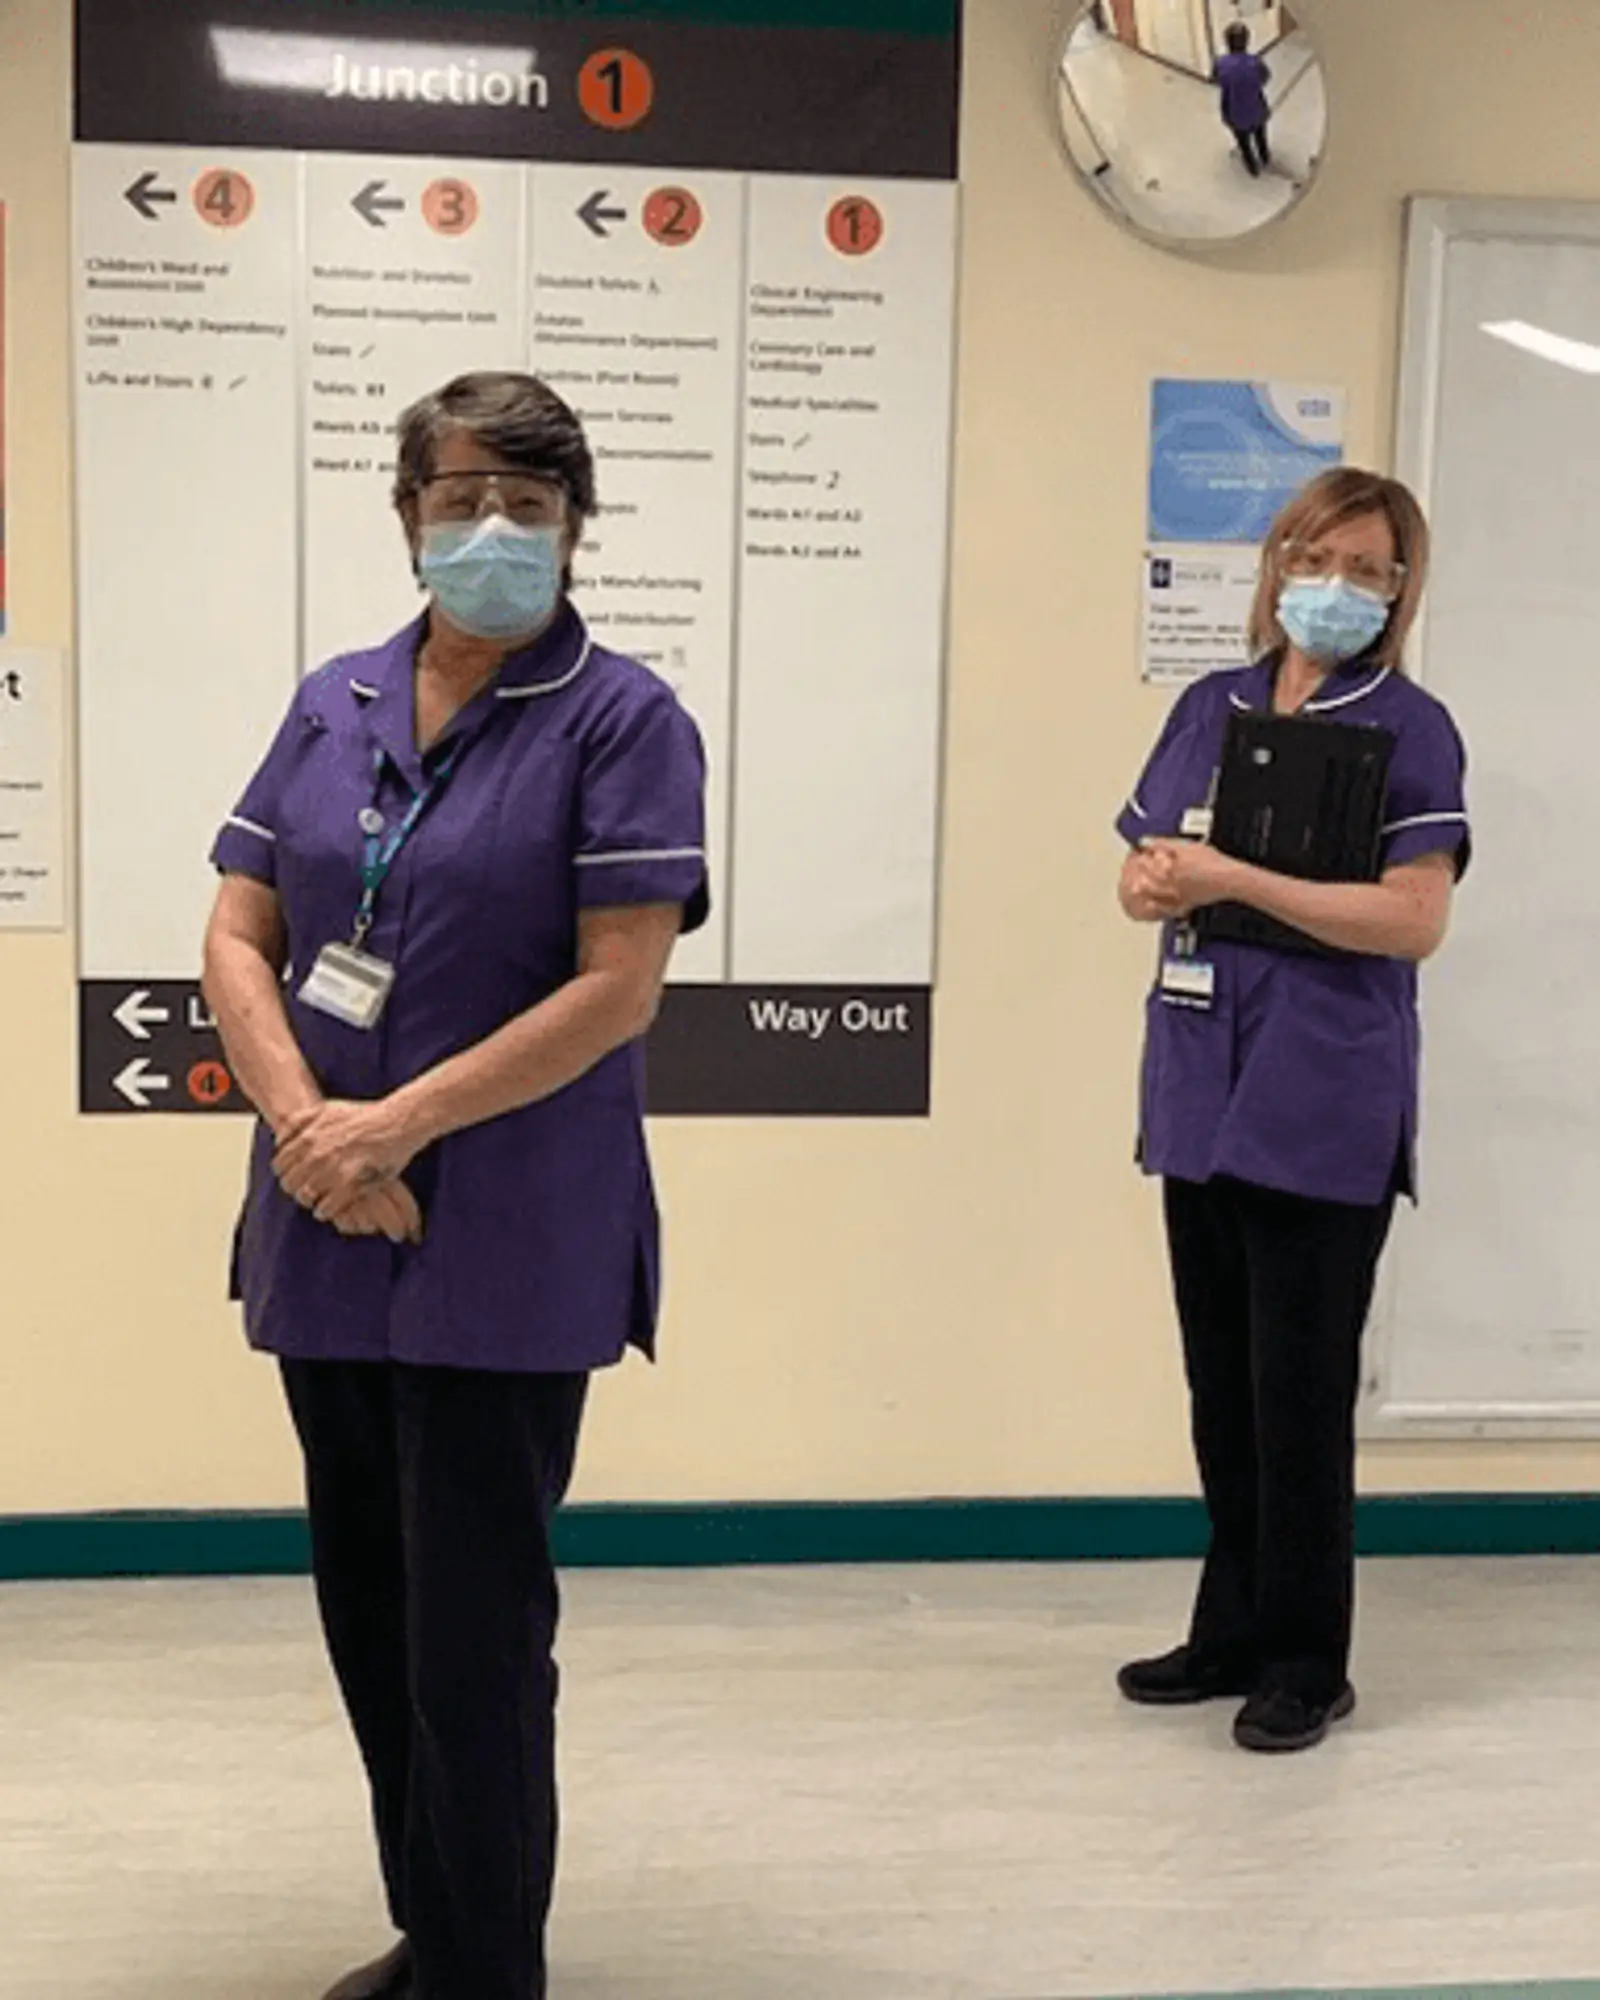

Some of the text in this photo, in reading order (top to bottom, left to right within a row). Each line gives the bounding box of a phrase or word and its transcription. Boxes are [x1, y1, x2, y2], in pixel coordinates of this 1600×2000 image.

[325, 54, 624, 115] Junction 1
[203, 174, 236, 220] 4
[436, 183, 465, 227] 3
[659, 194, 687, 236] 2
[842, 206, 862, 245] 1
[749, 1000, 909, 1039] Way Out
